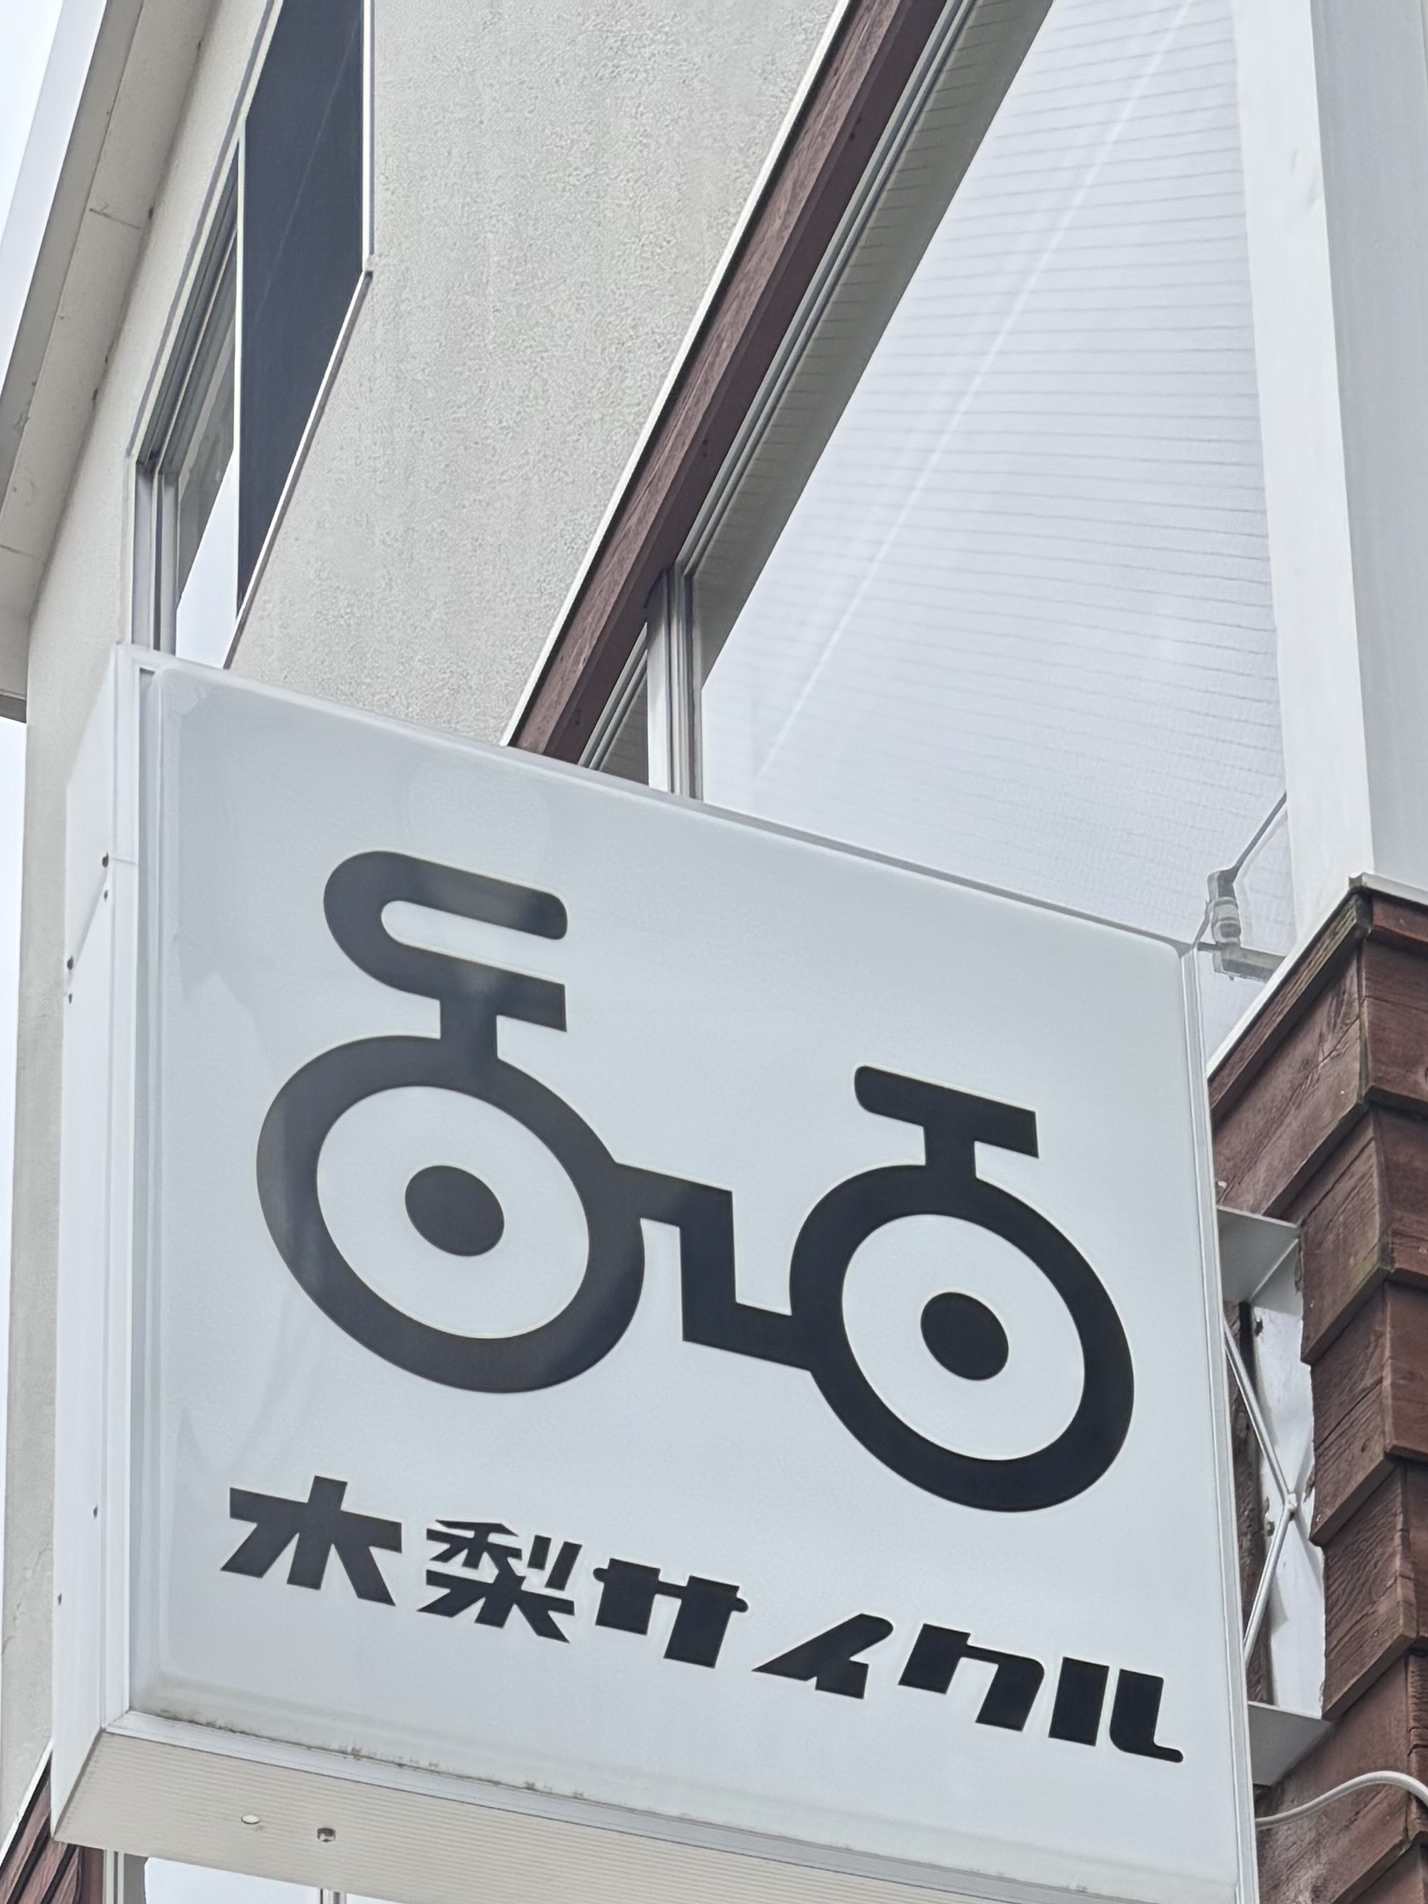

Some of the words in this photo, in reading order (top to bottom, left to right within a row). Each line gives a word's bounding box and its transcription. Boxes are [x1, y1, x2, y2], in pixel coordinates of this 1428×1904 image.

[221, 1476, 1183, 1763] 木梨サイクル
